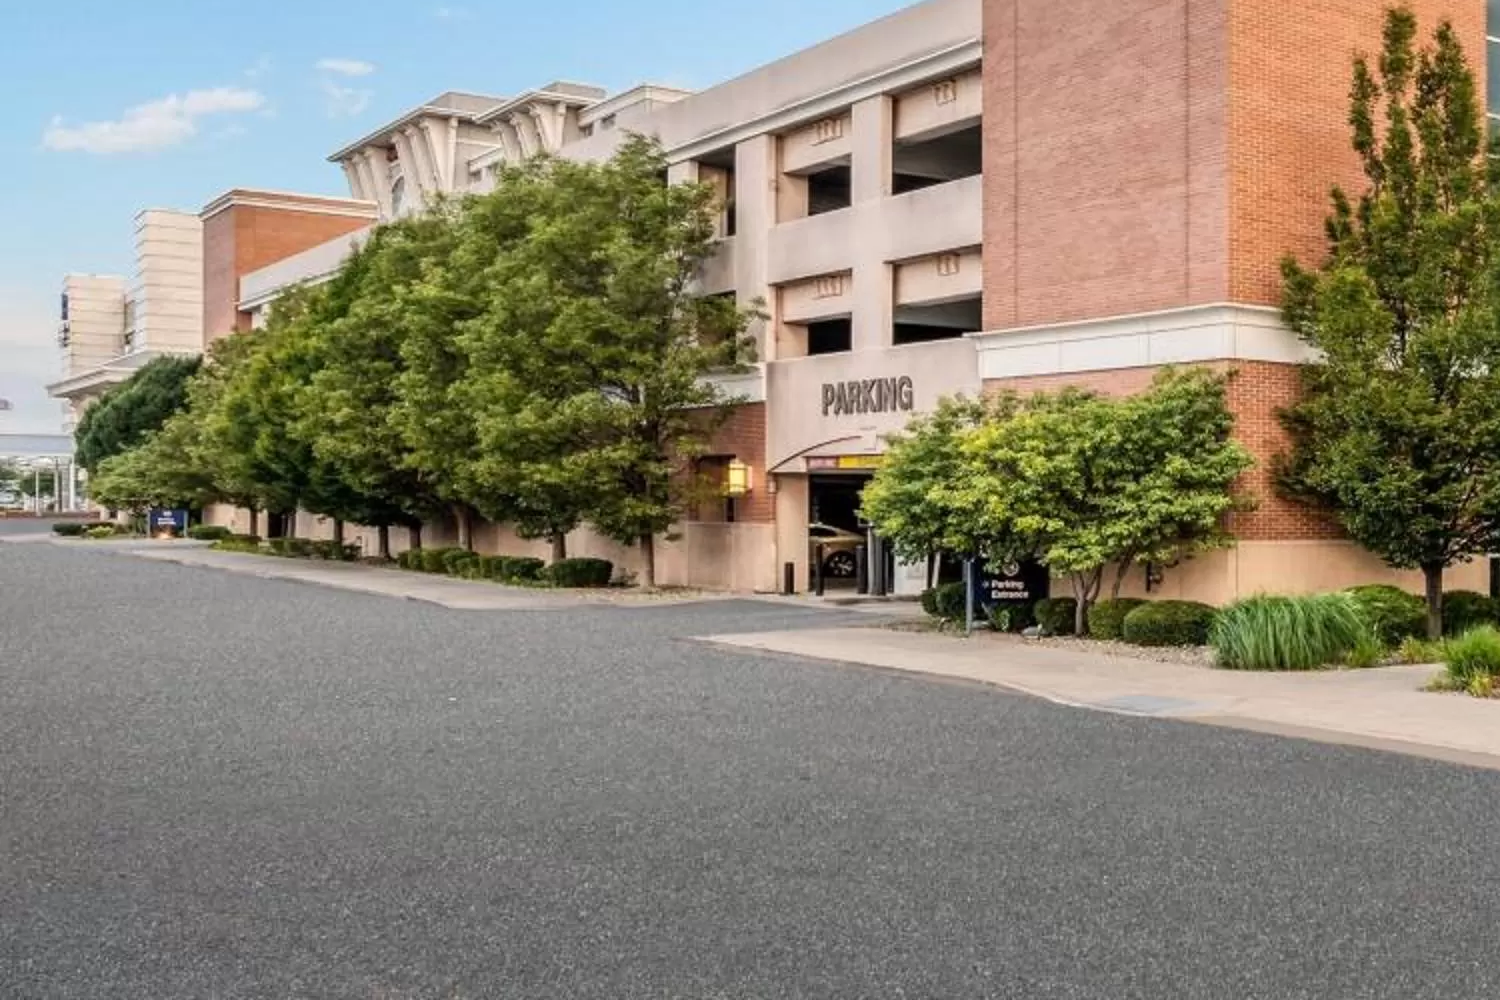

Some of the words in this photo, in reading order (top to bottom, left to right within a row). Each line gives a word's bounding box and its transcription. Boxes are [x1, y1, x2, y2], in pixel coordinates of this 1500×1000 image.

[821, 375, 914, 417] PARKING
[991, 580, 1025, 590] Parking
[991, 590, 1029, 599] Entrance
